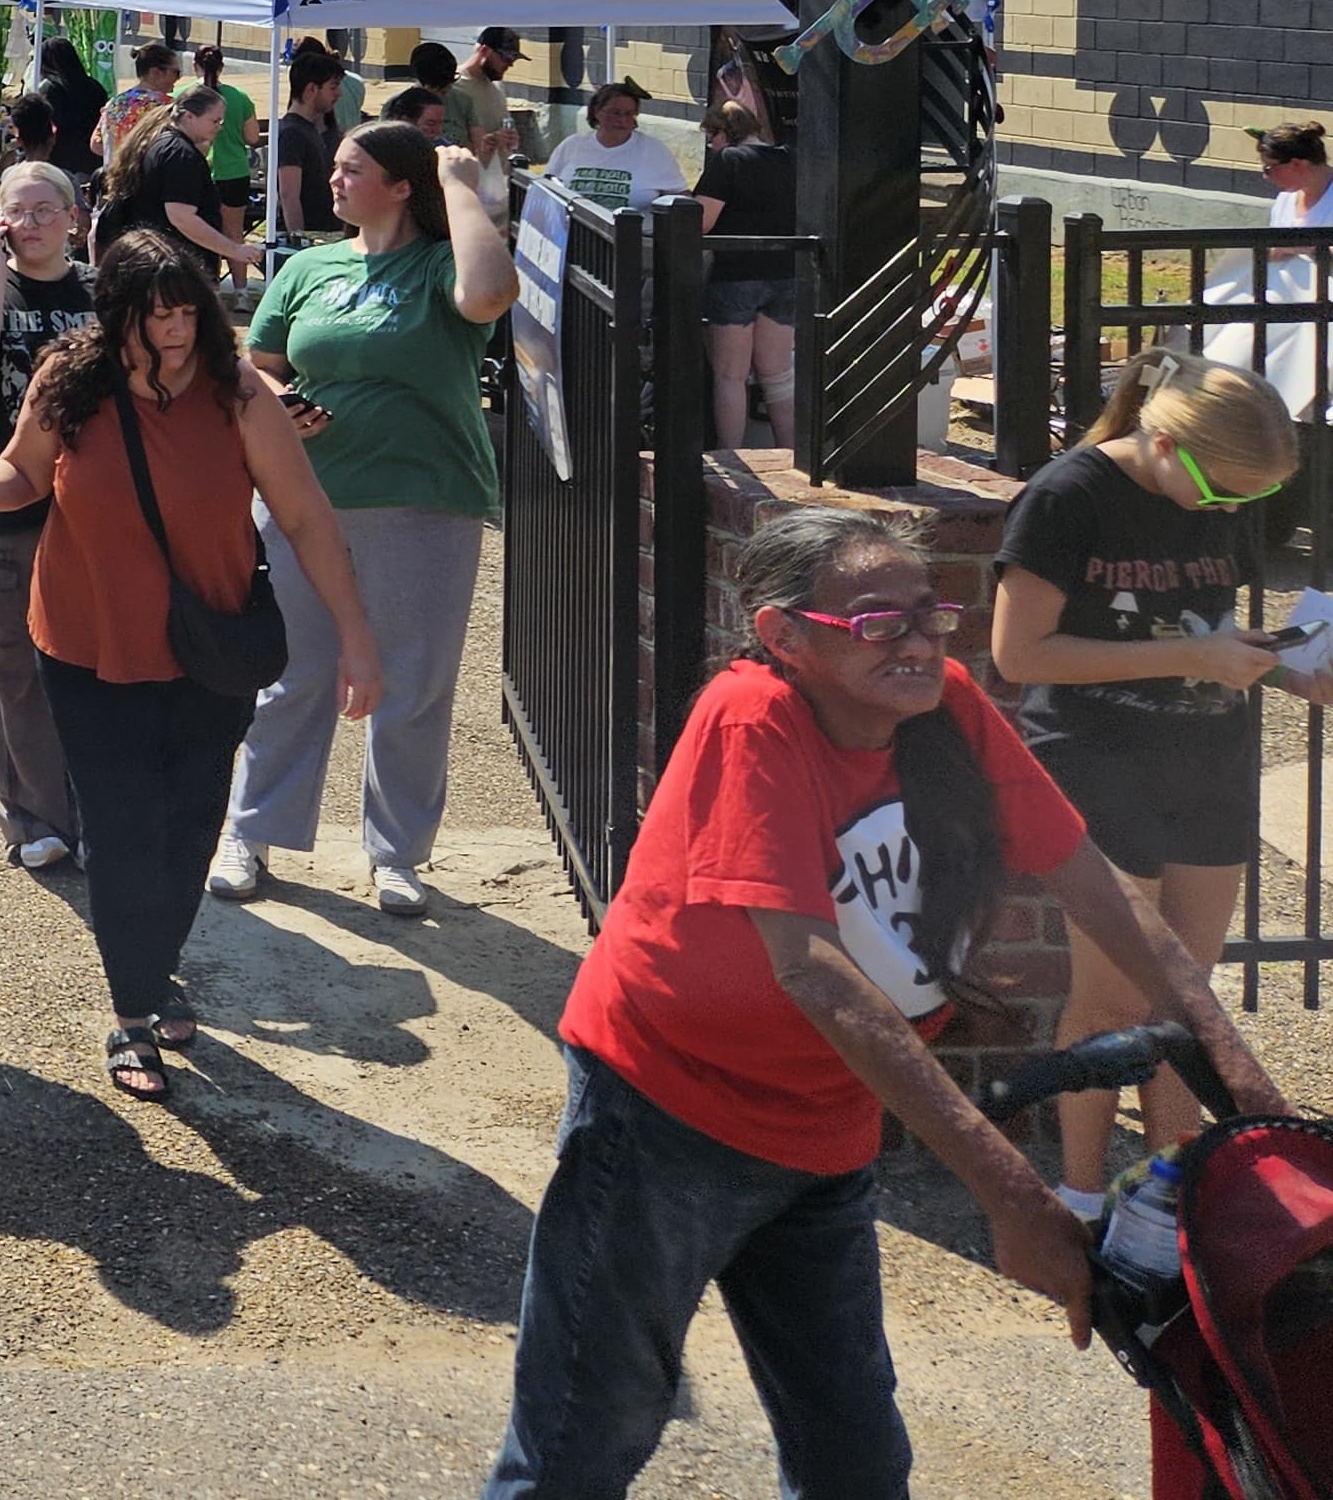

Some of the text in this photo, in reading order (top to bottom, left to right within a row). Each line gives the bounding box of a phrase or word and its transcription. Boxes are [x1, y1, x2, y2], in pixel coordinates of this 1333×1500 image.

[4, 309, 44, 332] HE
[1086, 556, 1232, 592] PIERCE THE
